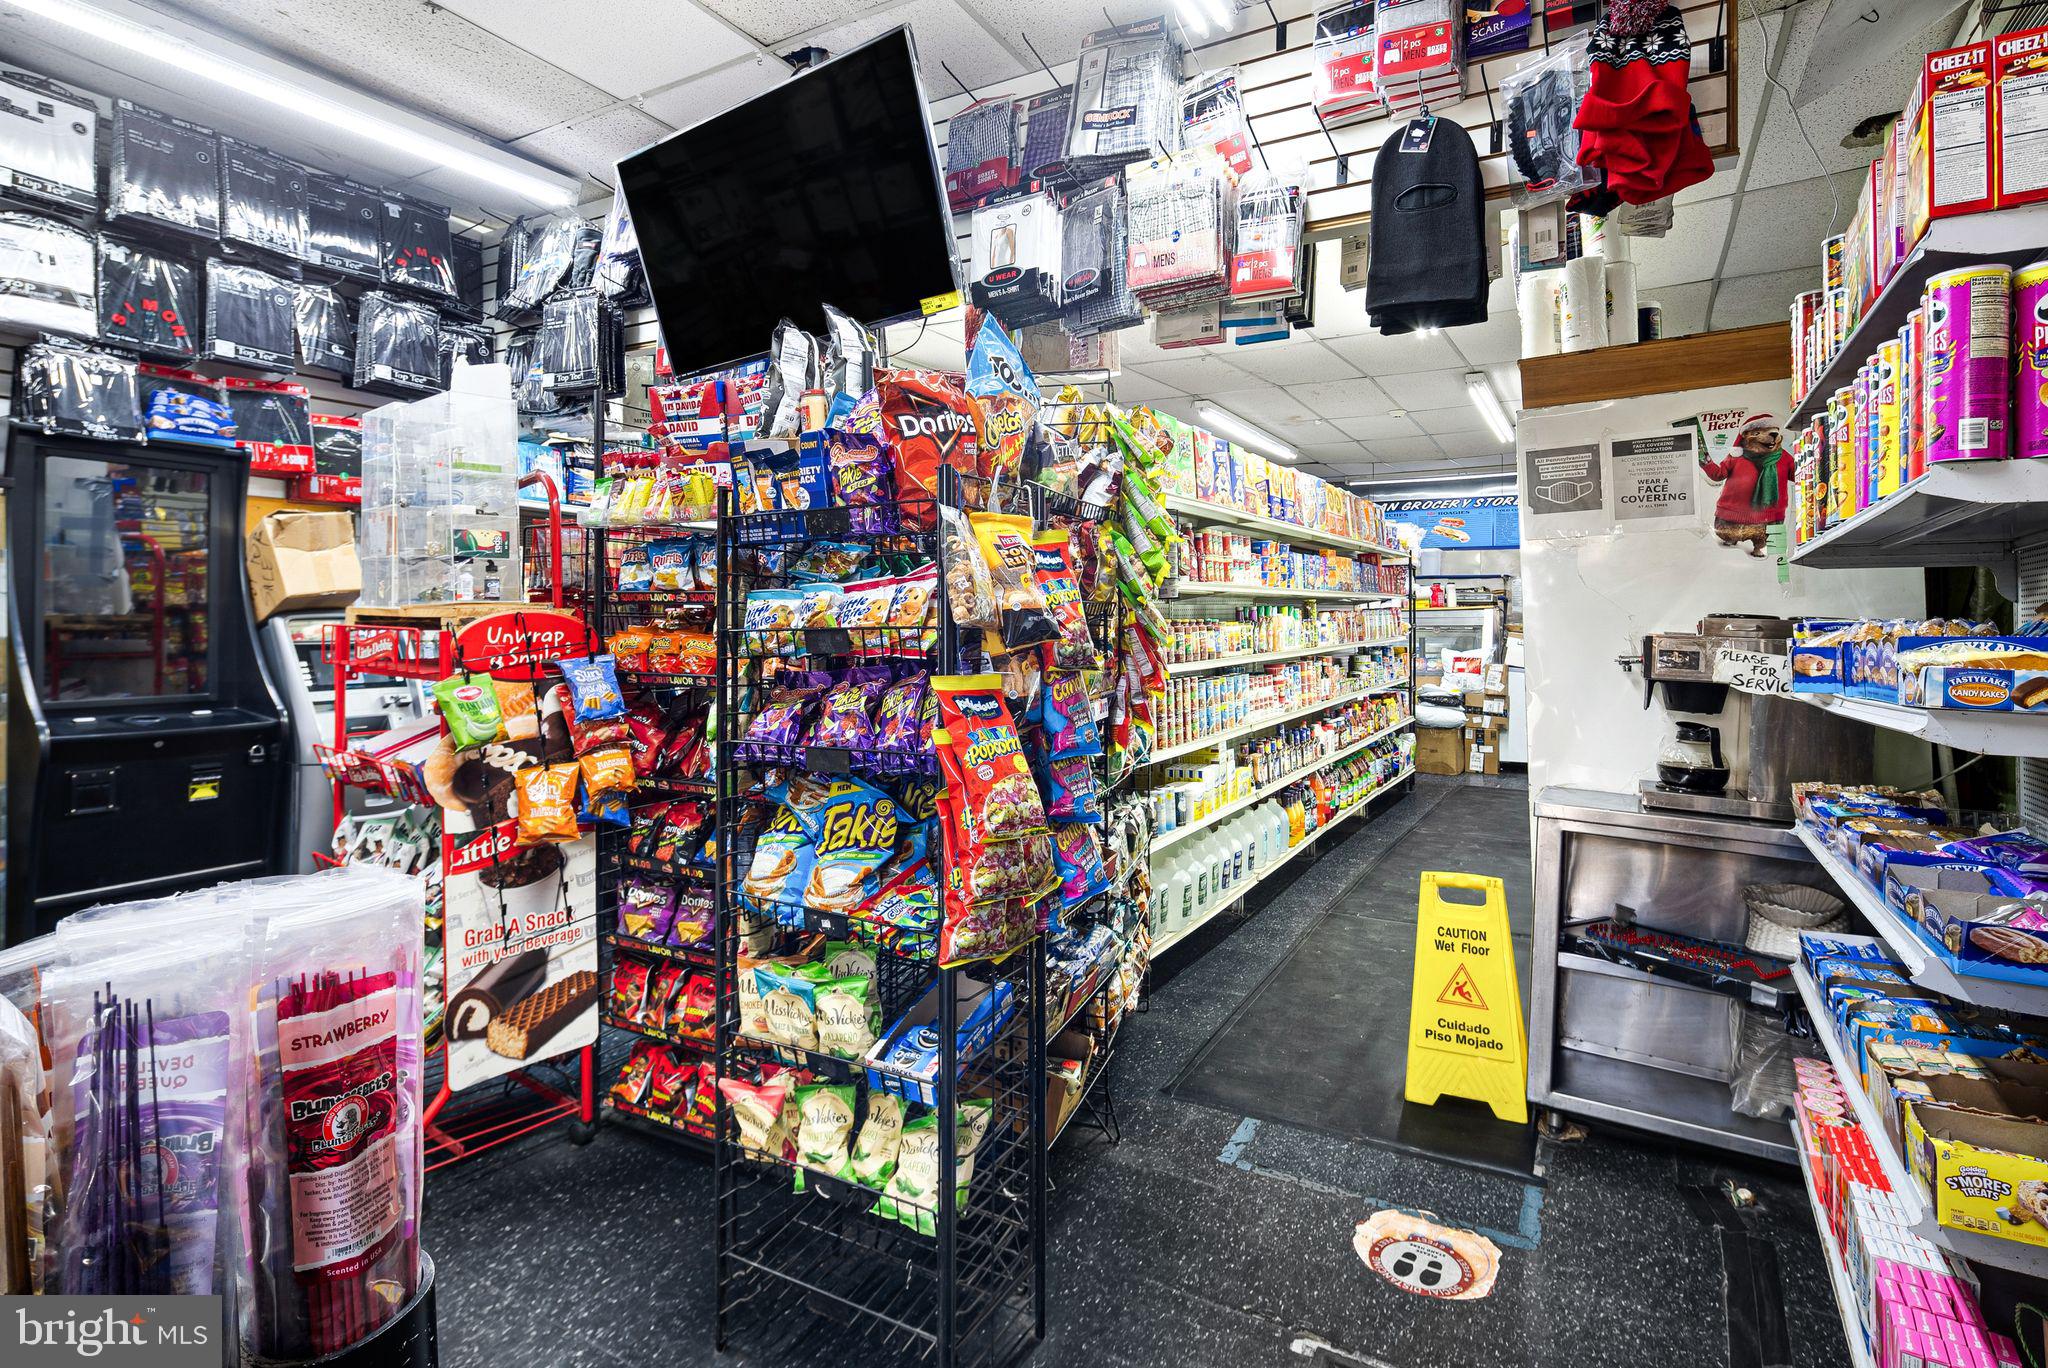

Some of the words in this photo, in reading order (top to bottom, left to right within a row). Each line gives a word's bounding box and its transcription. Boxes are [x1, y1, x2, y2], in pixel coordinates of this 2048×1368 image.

[1471, 20, 1505, 40] SCARF
[1410, 40, 1421, 49] pcs
[1403, 49, 1426, 60] MENS
[2013, 52, 2043, 66] DUOZ
[1340, 68, 1350, 76] pcs
[1944, 69, 1973, 82] DUOZ
[1935, 91, 1965, 100] Nutrition
[1935, 107, 1960, 115] Calories
[978, 170, 995, 179] BOXER
[978, 174, 998, 184] SHORTS
[16, 175, 42, 190] Top
[46, 182, 72, 197] Tee
[324, 254, 342, 268] Top
[344, 258, 362, 270] Tee
[1153, 252, 1176, 268] MENS
[1259, 260, 1269, 268] pcs
[988, 275, 994, 283] U
[995, 269, 1017, 282] WEAR
[1252, 268, 1272, 279] MENS
[1002, 284, 1020, 296] A-SHIRT
[112, 298, 187, 338] SIMON
[238, 347, 256, 361] Top
[257, 349, 275, 361] Tee
[393, 372, 410, 384] Top
[410, 374, 428, 384] Tee
[556, 374, 569, 382] Top
[676, 402, 697, 412] DAVID
[740, 393, 760, 406] DAVID
[1700, 409, 1745, 425] They're
[669, 422, 699, 433] DAVID
[899, 411, 976, 441] Doritos
[985, 408, 1024, 450] Cheetos
[1707, 418, 1741, 432] Here!
[801, 441, 817, 450] COUNT
[1634, 446, 1673, 454] NOTIFICATION
[1546, 454, 1591, 464] Pennsylvanians
[839, 464, 862, 486] Takis
[1549, 462, 1587, 473] encouraged
[1637, 485, 1668, 494] FACE
[1401, 497, 1470, 511] GROCERY
[1473, 495, 1519, 508] STORE
[1621, 492, 1687, 504] COVERING
[653, 553, 683, 568] RUFFLES
[842, 597, 869, 612] Little
[746, 604, 773, 623] Little
[751, 612, 778, 629] Bites
[842, 606, 873, 623] Bites
[486, 626, 564, 648] Unwrap
[617, 636, 643, 652] Cheetos
[356, 643, 373, 659] Little
[373, 640, 393, 656] Debbie
[508, 650, 563, 668] Smile
[1721, 650, 1769, 665] PLEASE
[573, 669, 603, 681] Sun
[1751, 666, 1779, 679] FOR
[666, 677, 694, 685] FLAVOR
[1729, 674, 1791, 693] SERVIC
[1949, 676, 2010, 688] TASTYKAKE
[1952, 688, 1979, 698] KANDY
[1980, 689, 2007, 699] KAKES
[968, 726, 1008, 745] PARTY
[969, 737, 1021, 768] Popcorn
[816, 803, 897, 855] Takis
[452, 835, 511, 869] Little
[628, 887, 667, 905] Doritos
[682, 894, 714, 910] Doritos
[465, 921, 504, 948] Grab
[510, 918, 520, 935] A
[526, 909, 575, 932] Snack
[1437, 926, 1487, 942] CAUTION
[462, 949, 490, 968] with
[494, 941, 522, 965] your
[524, 926, 582, 951] Beverage
[1434, 939, 1455, 953] Wet
[1461, 942, 1490, 957] Floor
[834, 1004, 867, 1029] Vickie's
[291, 1009, 389, 1051] STRAWBERRY
[1437, 1018, 1491, 1035] Cuidado
[1425, 1029, 1452, 1043] Piso
[1455, 1036, 1504, 1051] Mojado
[1903, 1038, 1933, 1049] Kellogg's
[895, 1050, 921, 1062] OREO
[816, 1104, 848, 1129] Vickie's
[1960, 1165, 1987, 1174] Golden
[1945, 1176, 2012, 1196] S'MORES
[1961, 1187, 2000, 1201] TREATS
[326, 1262, 360, 1277] Scented
[361, 1257, 369, 1267] in
[370, 1247, 383, 1261] USA
[1371, 1255, 1422, 1295] DISTANCING
[1430, 1284, 1465, 1298] SOCIAL
